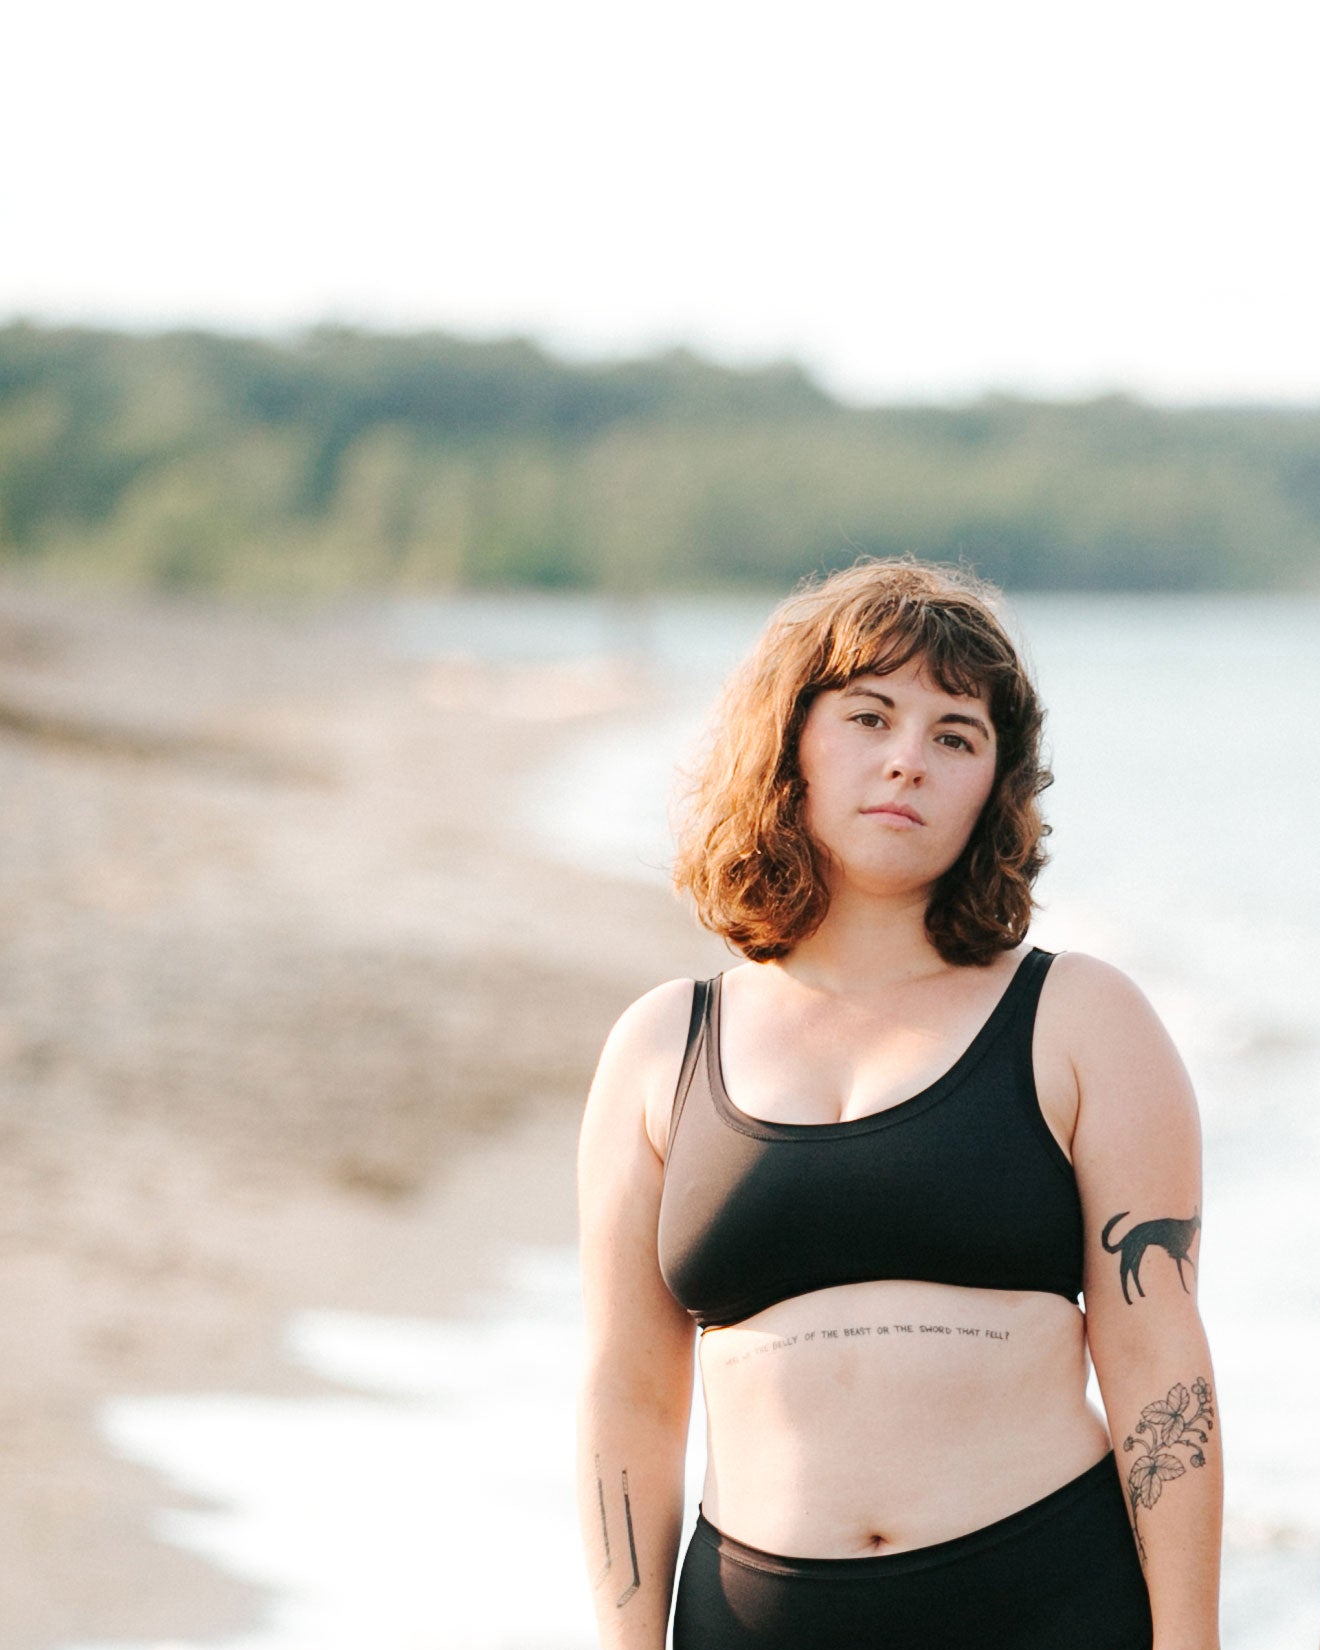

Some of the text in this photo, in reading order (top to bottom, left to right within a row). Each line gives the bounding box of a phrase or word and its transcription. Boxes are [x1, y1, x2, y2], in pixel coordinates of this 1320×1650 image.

[804, 1331, 815, 1341] OF
[821, 1330, 839, 1339] THE
[844, 1326, 871, 1337] BEAST
[876, 1326, 889, 1335] OR
[894, 1325, 914, 1333] THE
[919, 1325, 952, 1335] SWORD
[956, 1327, 980, 1336] THAT
